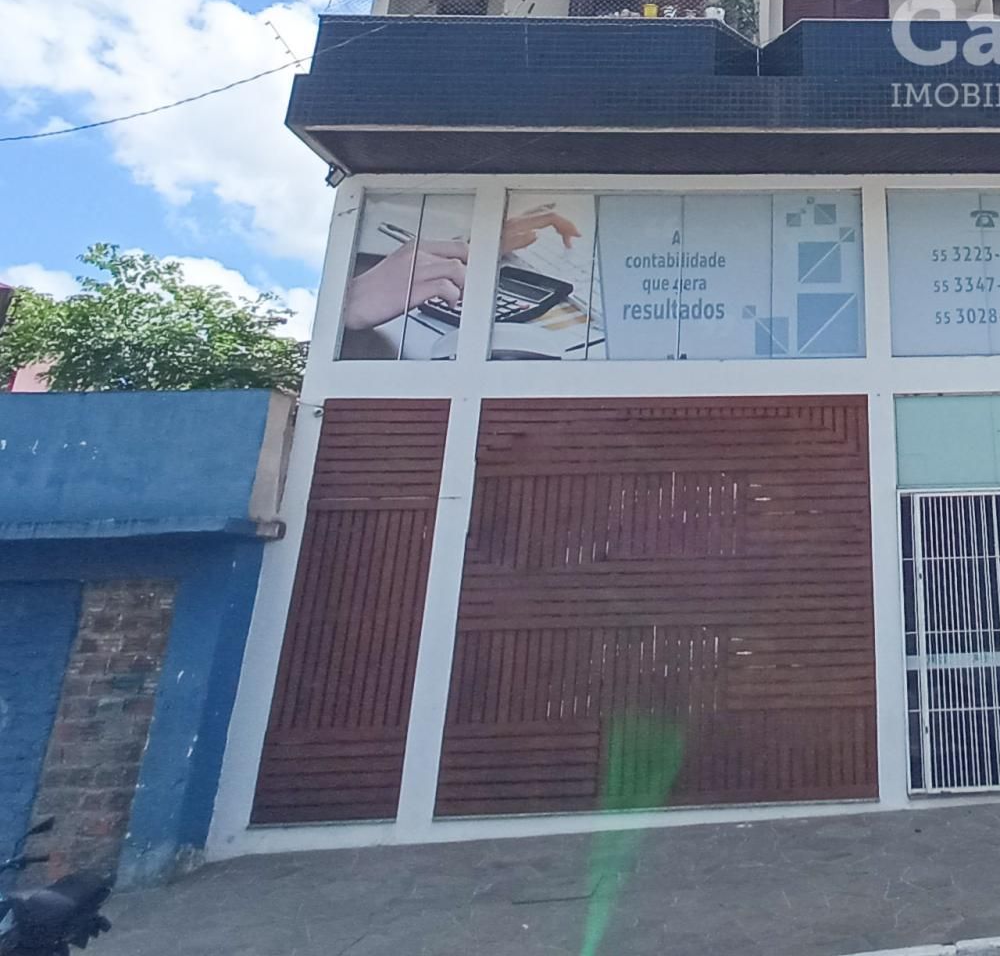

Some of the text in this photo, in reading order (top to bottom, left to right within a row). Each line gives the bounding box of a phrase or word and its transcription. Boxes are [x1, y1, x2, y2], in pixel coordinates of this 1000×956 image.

[671, 230, 681, 245] A
[625, 252, 726, 268] contabilidade
[932, 249, 948, 262] 55
[642, 277, 669, 295] que
[933, 279, 949, 293] 55
[623, 298, 725, 320] resultados
[935, 311, 951, 325] 55
